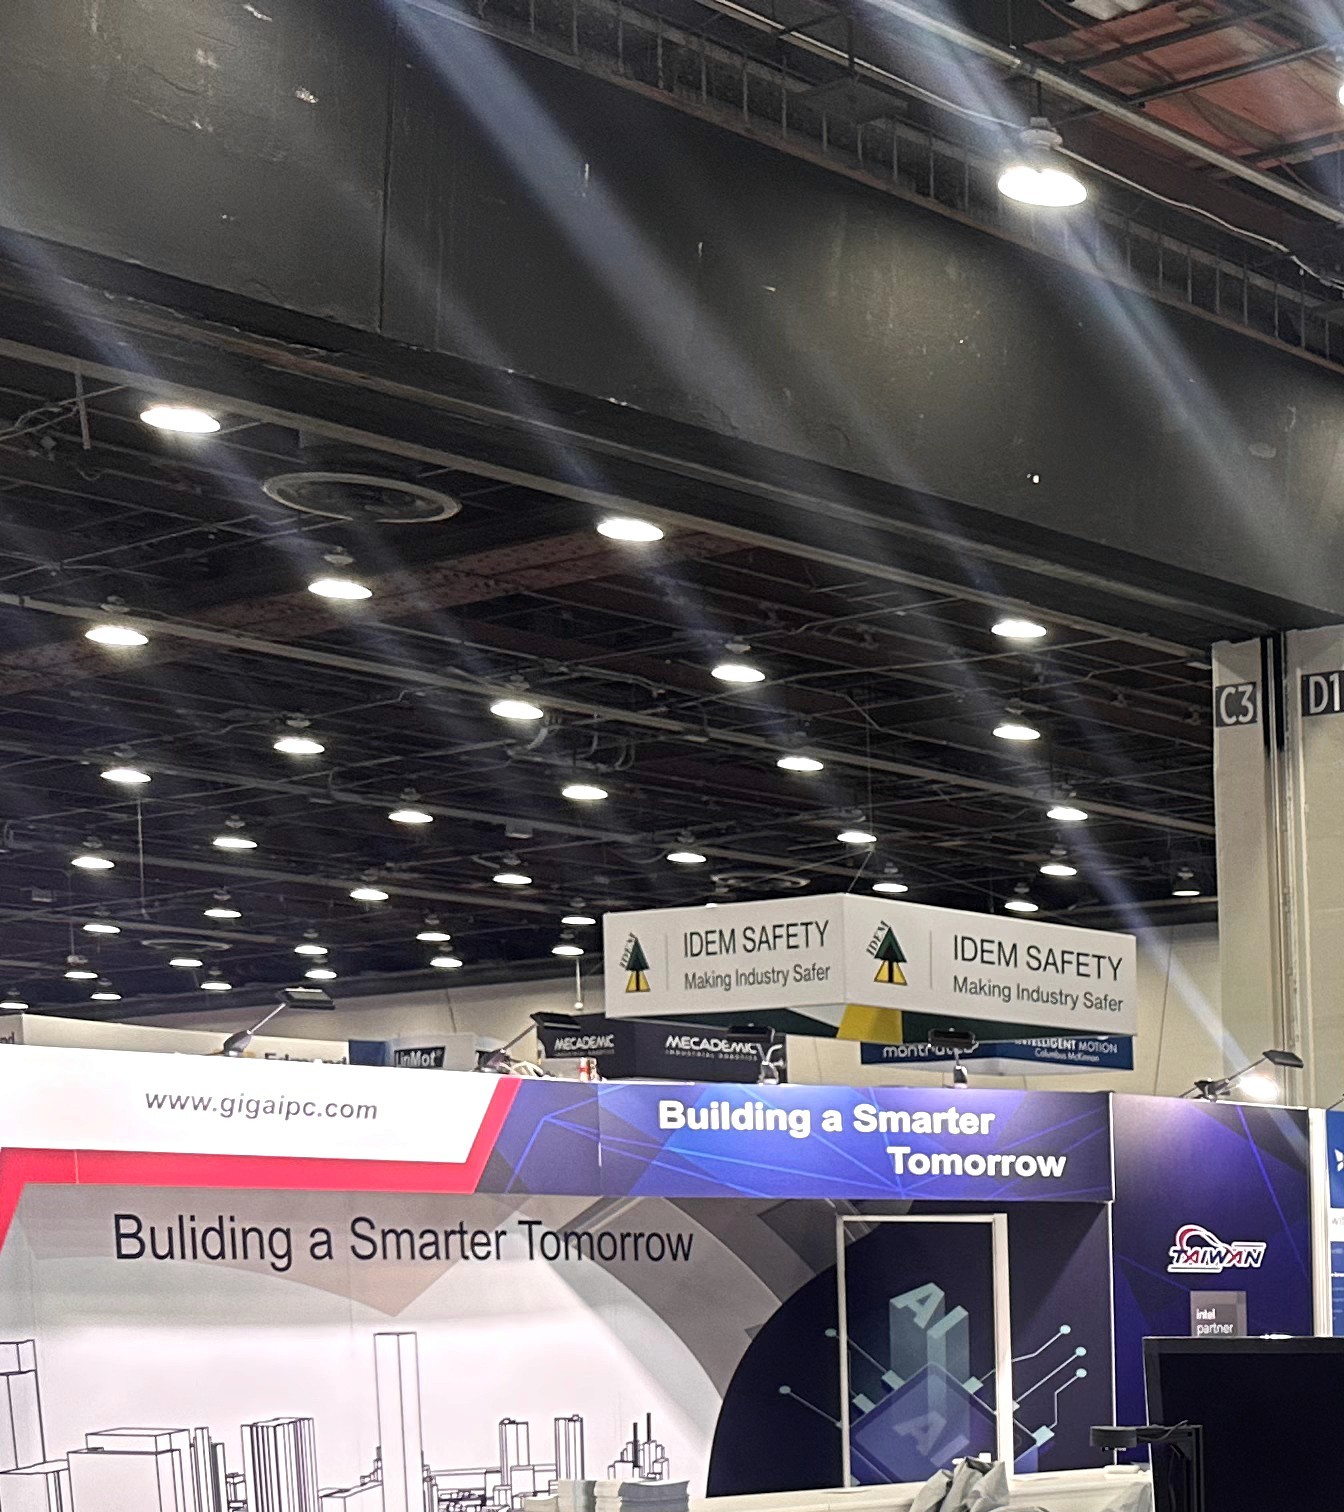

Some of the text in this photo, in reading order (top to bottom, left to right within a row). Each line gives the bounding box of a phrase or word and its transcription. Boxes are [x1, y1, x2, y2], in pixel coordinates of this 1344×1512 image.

[1219, 685, 1255, 725] C3
[1309, 671, 1341, 714] D1
[684, 920, 830, 958] IDEM SAFETY
[953, 934, 1123, 981] IDEM SAFETY
[684, 963, 831, 992] Making Industry Safer
[953, 975, 1123, 1012] Making Industry Safer
[665, 1035, 758, 1055] MECADEMIC
[1078, 1040, 1118, 1054] MOTION
[145, 1092, 378, 1120] www.gigaipc.com
[658, 1102, 996, 1139] Building a Smarter
[886, 1147, 1067, 1179] Tomorrow
[309, 1224, 334, 1261] a
[350, 1216, 508, 1262] Smarter
[518, 1220, 694, 1263] Tomorrow
[1169, 1242, 1266, 1271] TAIWAN
[1196, 1308, 1216, 1320] intel
[1197, 1322, 1234, 1336] partner
